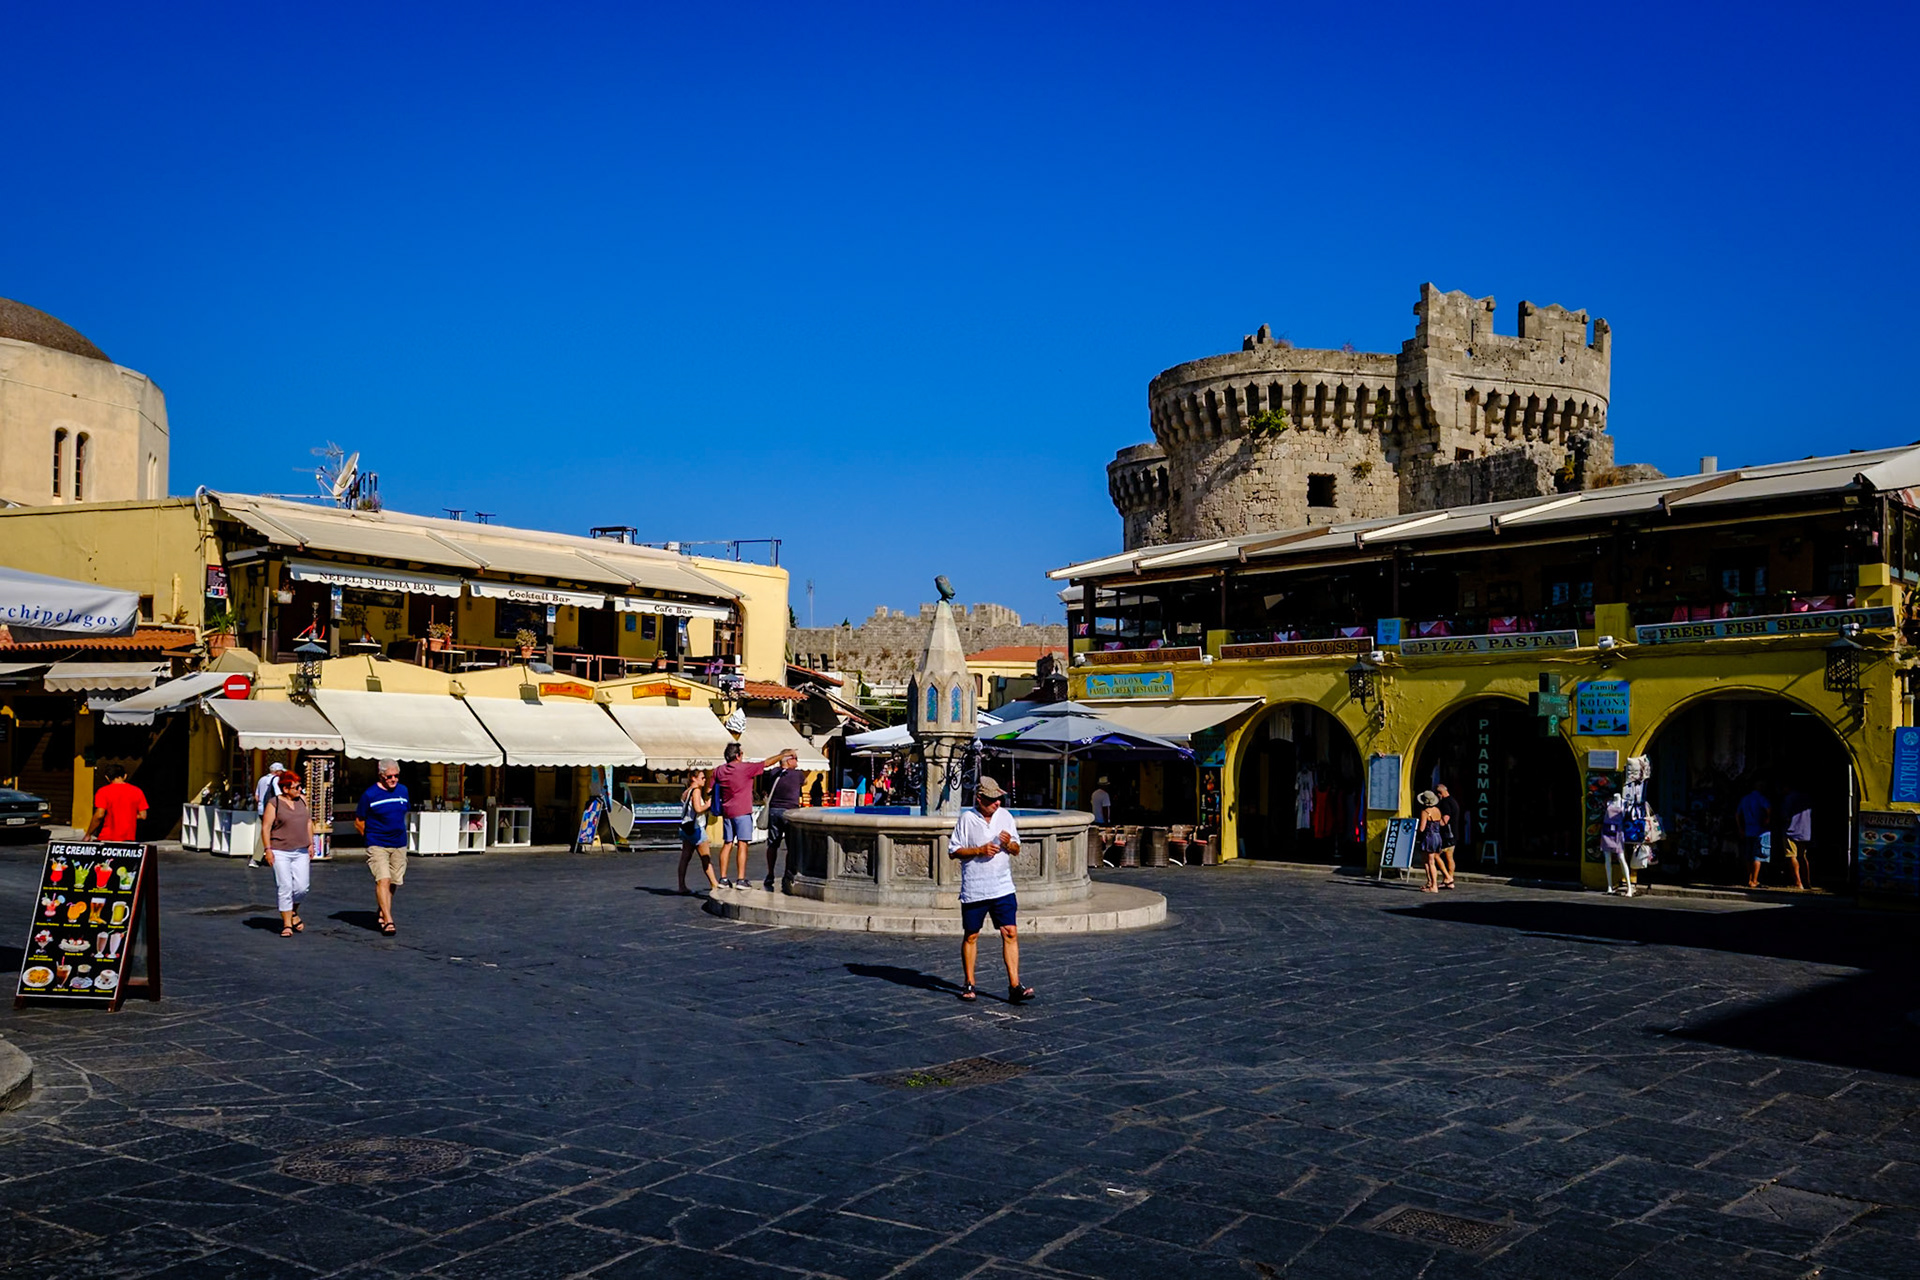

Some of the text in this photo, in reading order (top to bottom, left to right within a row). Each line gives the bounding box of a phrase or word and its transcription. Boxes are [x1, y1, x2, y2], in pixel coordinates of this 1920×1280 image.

[319, 572, 436, 592] NEFELI SHISHA BAR
[508, 589, 571, 603] Cocktail Bar
[654, 604, 693, 614] Cafe Bar
[1659, 613, 1868, 639] FRESH FISH SEAFOOD
[1232, 640, 1359, 657] STEAK HOUSE
[1418, 635, 1557, 652] PIZZA PASTA
[1094, 650, 1189, 663] GREEK RESTAURANT
[1113, 676, 1143, 686] KOLONA
[1089, 684, 1171, 696] FAMILY GREEK RESTAURANT
[1580, 699, 1627, 707] KOLONA
[1477, 719, 1490, 833] PHARMACY
[1899, 748, 1919, 798] SALTYBLUE
[1385, 820, 1399, 865] PHARMACY
[51, 845, 65, 854] ICE
[65, 845, 97, 856] CREAMS
[101, 847, 143, 858] COCKTAILS
